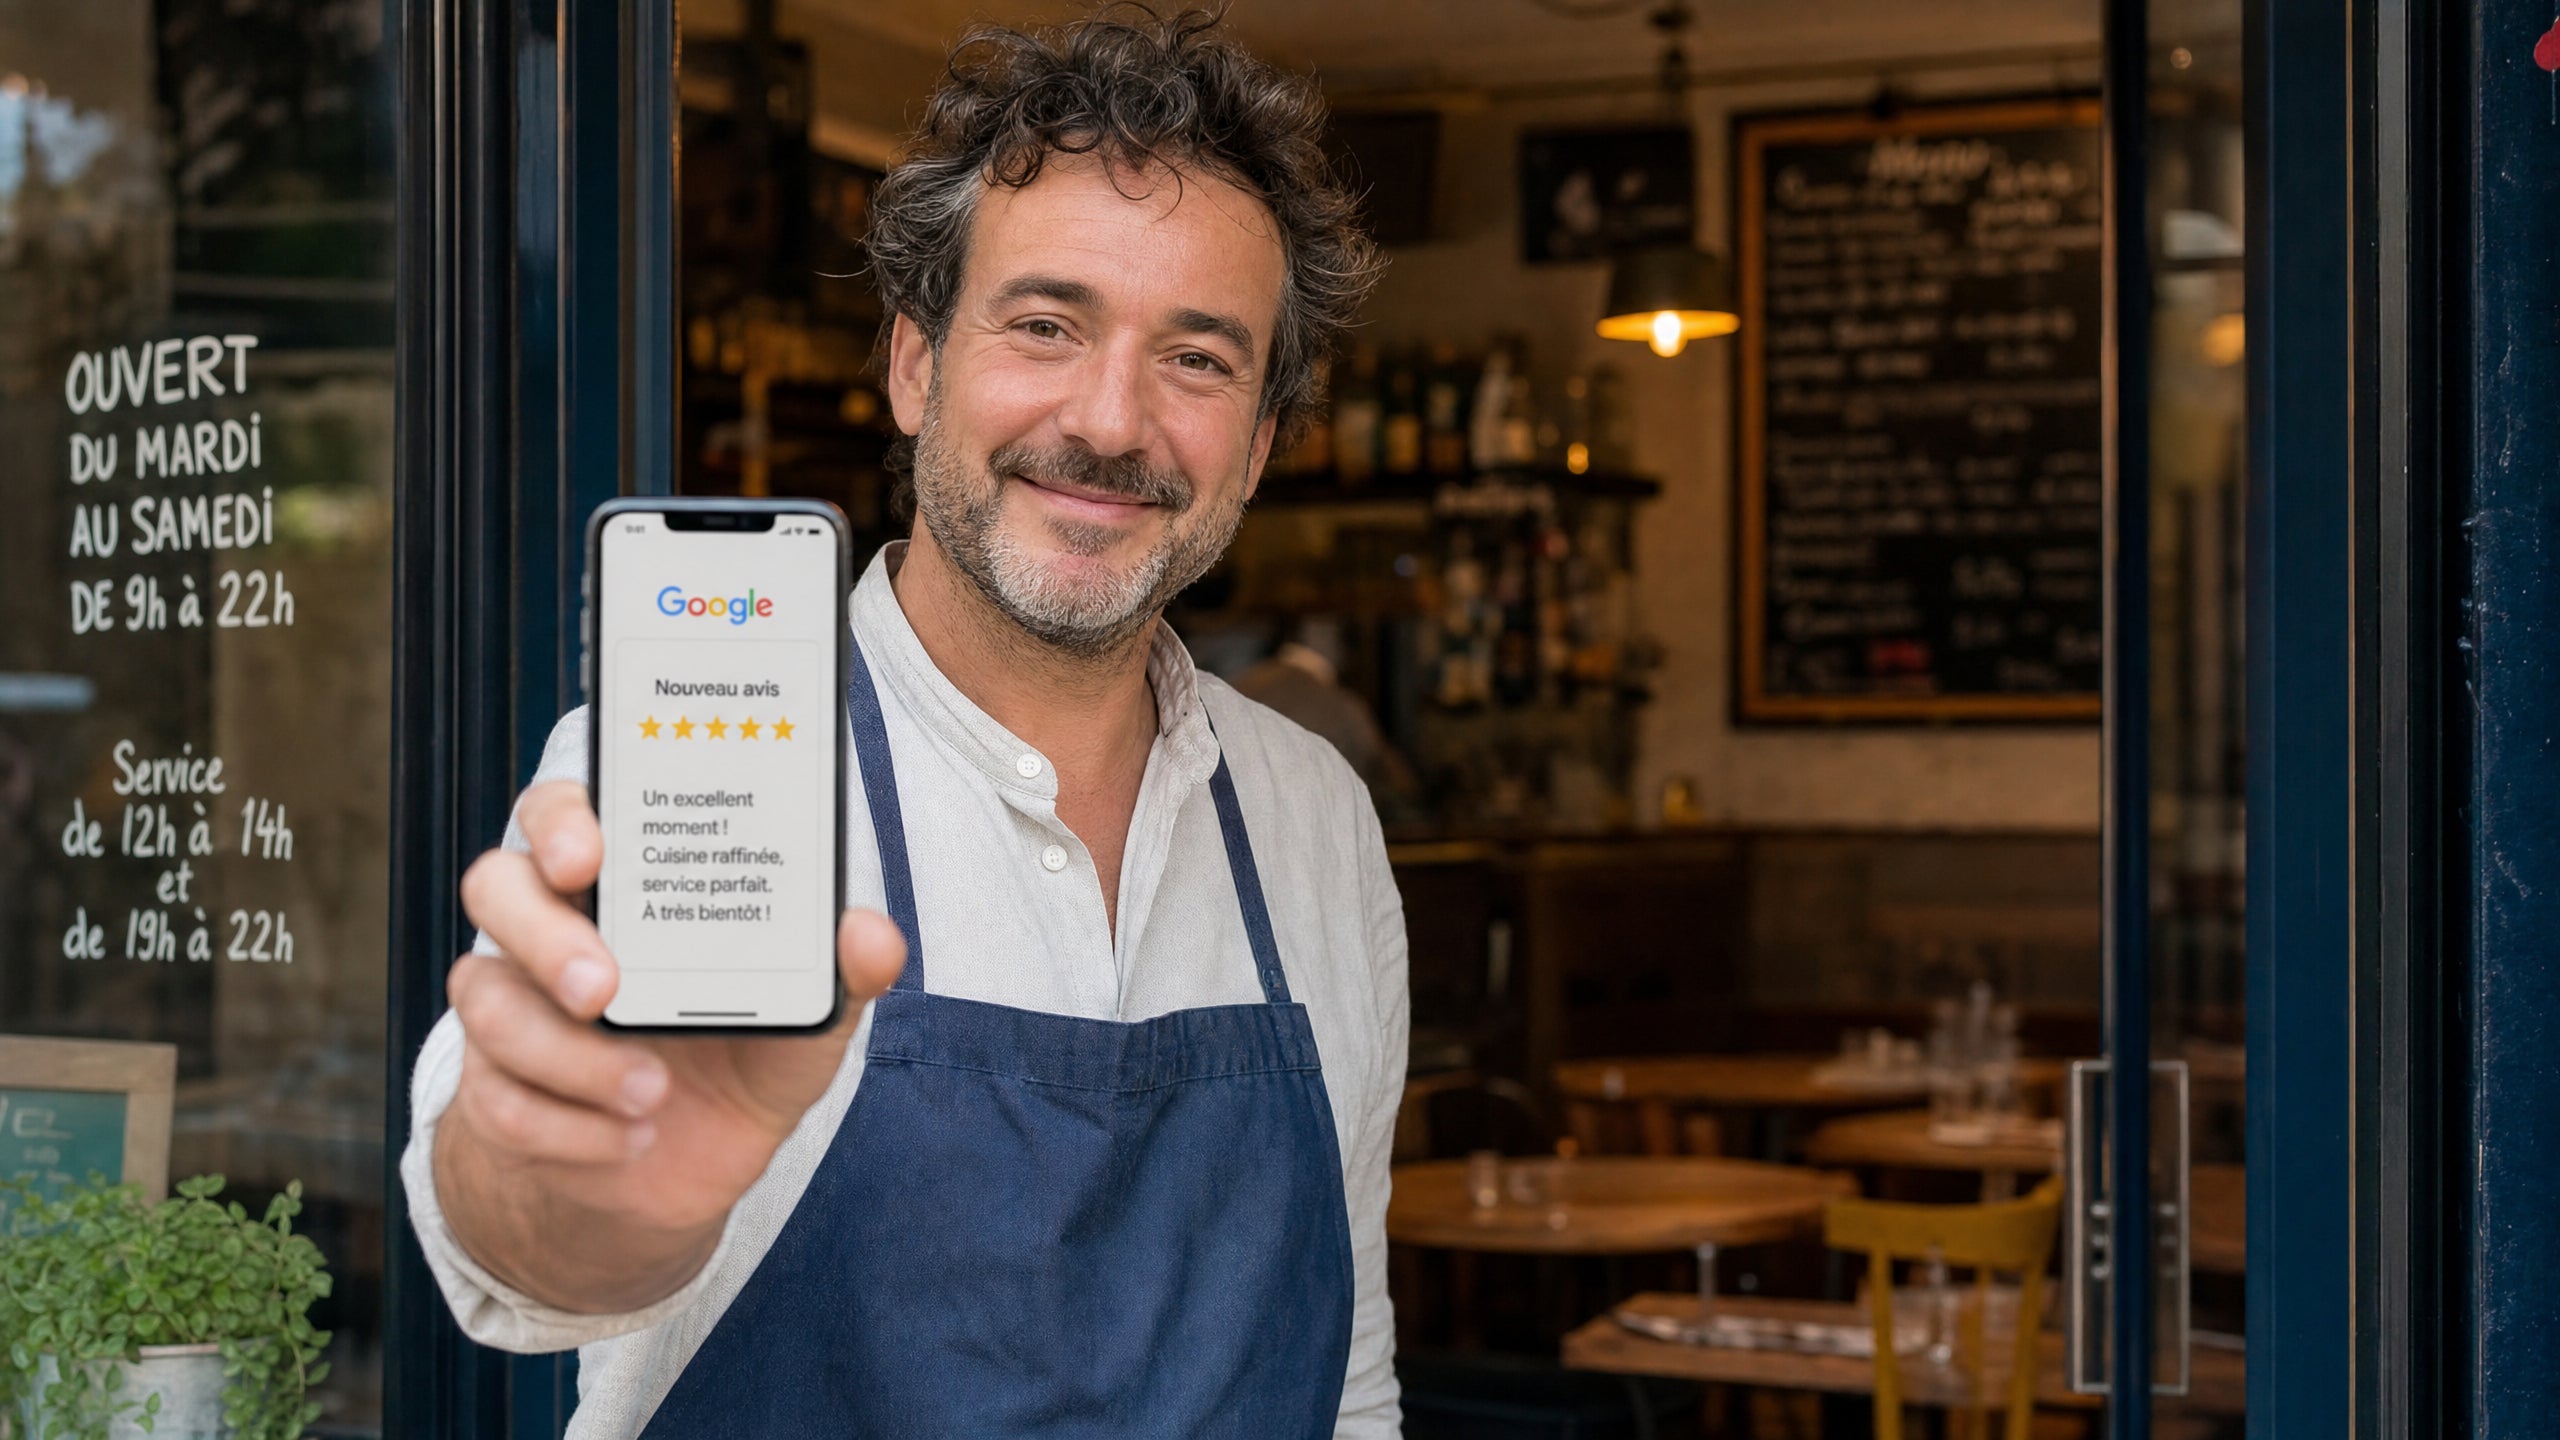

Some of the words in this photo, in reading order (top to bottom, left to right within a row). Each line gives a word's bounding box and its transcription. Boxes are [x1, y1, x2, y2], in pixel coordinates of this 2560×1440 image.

[65, 334, 259, 415] OUVERT
[69, 432, 118, 485] DU
[69, 504, 119, 558] AU
[70, 578, 114, 634] DE
[125, 573, 166, 631] 9h
[177, 575, 203, 628] à
[216, 570, 294, 628] 22h
[656, 585, 774, 626] Google
[655, 679, 738, 697] Nouveau
[743, 680, 780, 697] avis
[112, 739, 226, 796] Service
[642, 790, 669, 807] Un
[673, 789, 755, 807] excellent
[62, 798, 104, 858] de
[121, 804, 177, 858] 12h
[188, 801, 213, 857] à
[240, 797, 294, 861] 14h
[642, 820, 719, 836] moment
[723, 818, 729, 836] !
[642, 845, 709, 865] Cuisine
[711, 846, 785, 867] raffinée,
[156, 859, 194, 905] et
[642, 875, 706, 894] service
[710, 875, 774, 897] parfait.
[642, 899, 657, 921] À
[660, 902, 695, 921] très
[699, 903, 762, 921] bientôt
[765, 904, 771, 921] !
[62, 906, 105, 960] de
[125, 909, 176, 962] 19h
[186, 907, 211, 961] à
[226, 909, 294, 963] 22h
